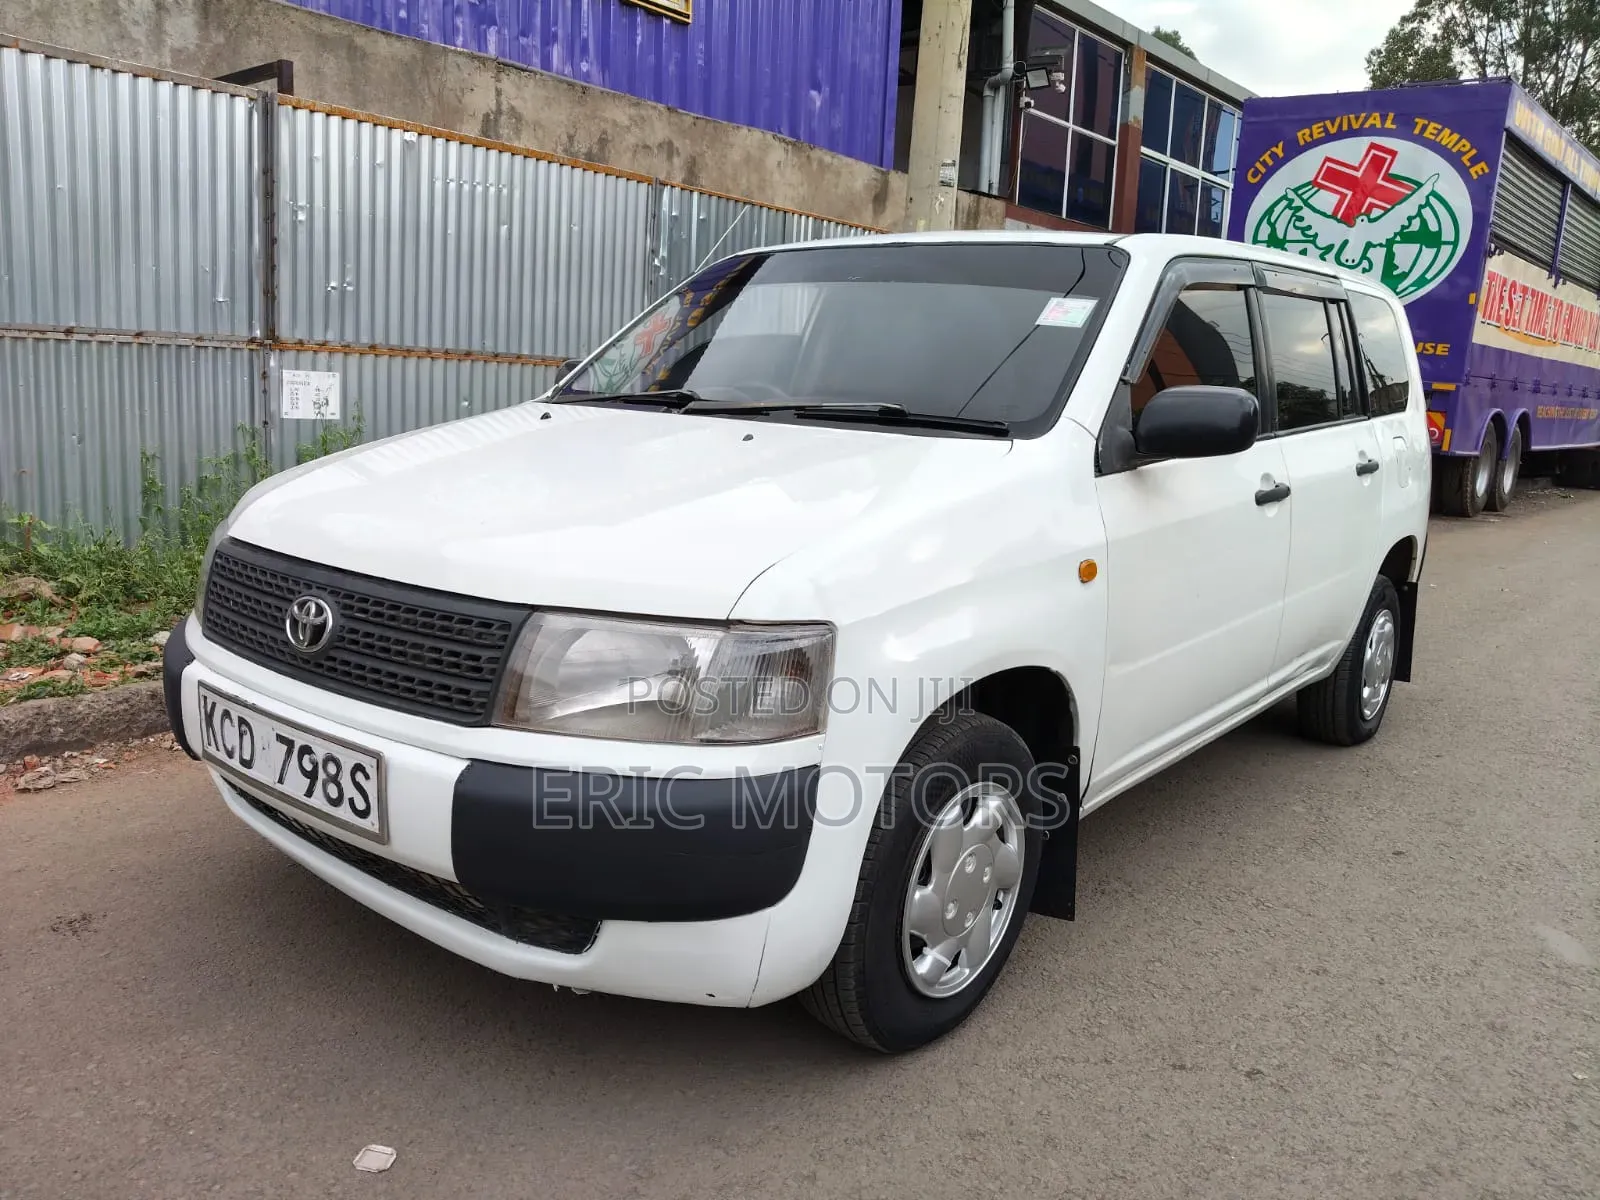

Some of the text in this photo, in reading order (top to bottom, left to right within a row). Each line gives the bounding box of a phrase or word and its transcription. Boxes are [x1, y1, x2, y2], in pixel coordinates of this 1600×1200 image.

[1247, 112, 1489, 184] CITY REVIVAL TEMPLE
[1482, 269, 1508, 324] THE
[1504, 279, 1529, 330] SET
[202, 694, 372, 820] KCD 798S
